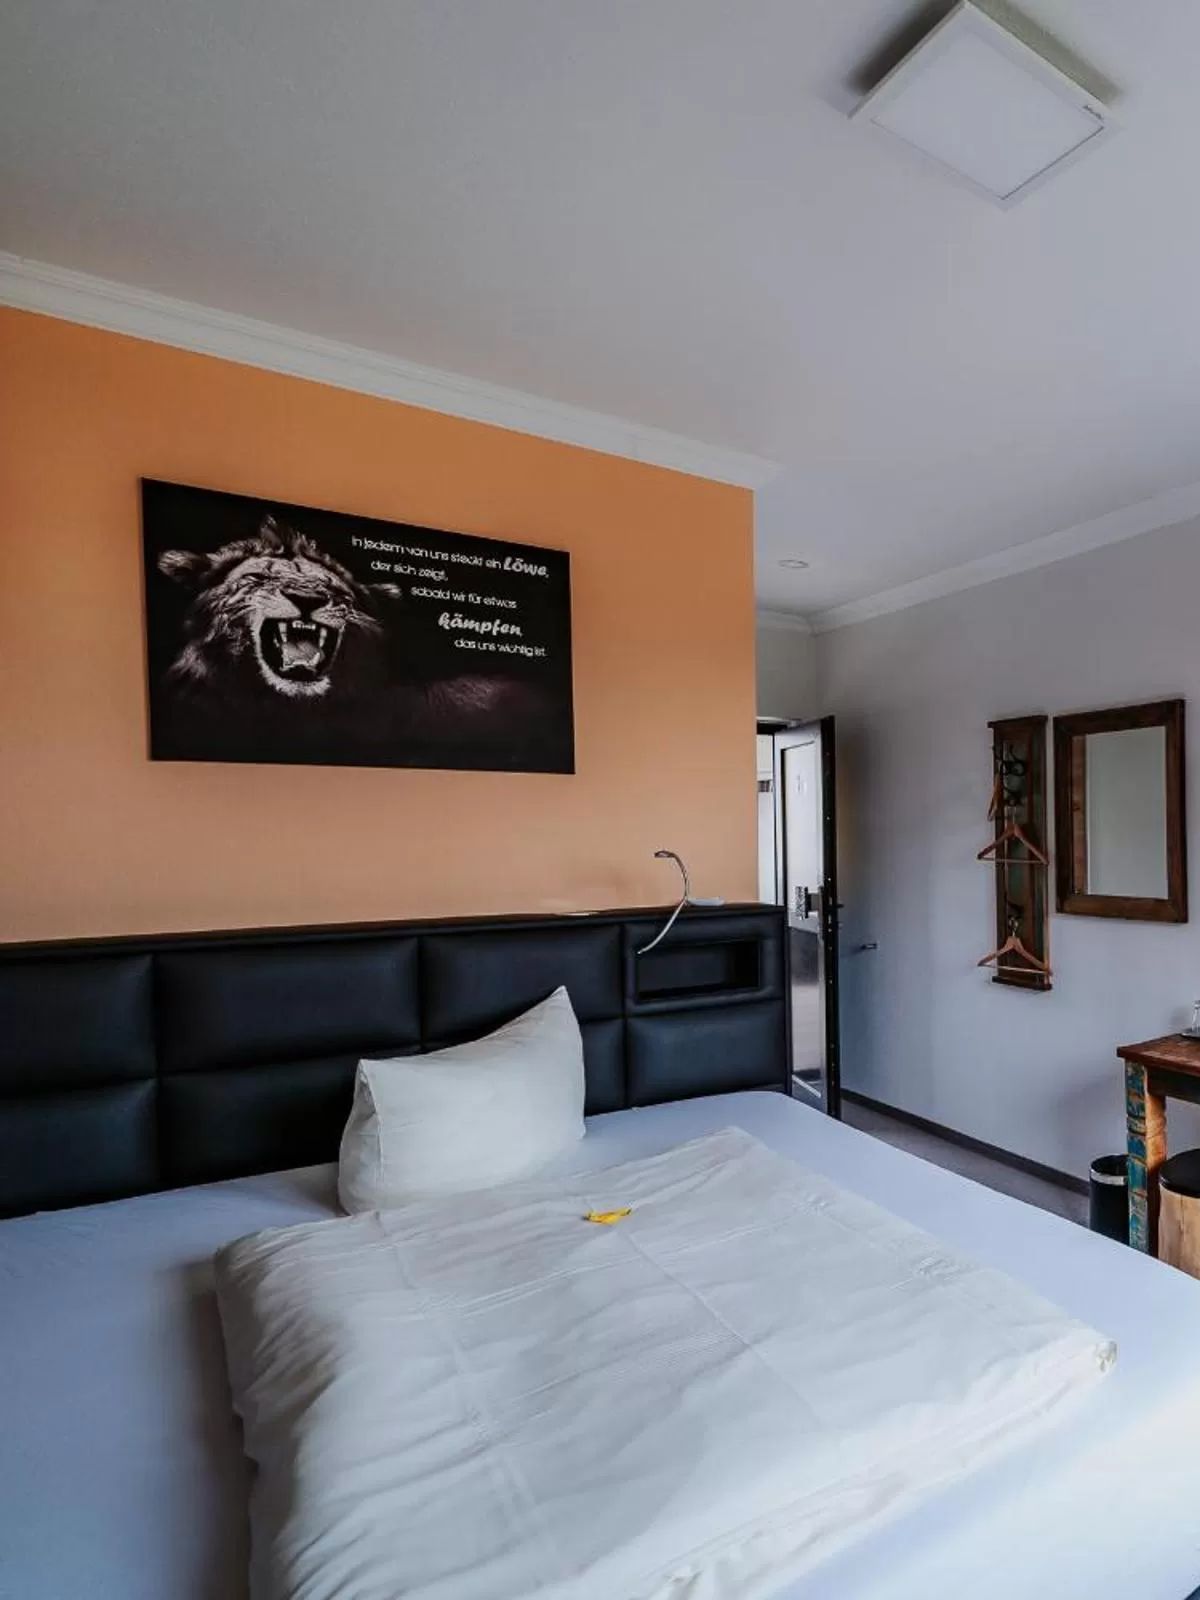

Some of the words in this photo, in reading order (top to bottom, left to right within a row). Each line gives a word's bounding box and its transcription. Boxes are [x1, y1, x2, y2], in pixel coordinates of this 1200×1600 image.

[351, 534, 362, 547] In
[364, 537, 405, 554] jedem
[406, 546, 428, 558] von
[430, 549, 449, 561] uns
[450, 552, 483, 567] steckt
[485, 558, 501, 569] ein
[503, 556, 550, 579] Löwe,
[370, 560, 391, 572] der
[393, 563, 417, 576] sich
[418, 568, 449, 582] zeigt,
[410, 586, 450, 600] sobald
[451, 591, 466, 602] wir
[467, 592, 482, 604] für
[482, 596, 517, 609] etwas
[438, 611, 523, 637] kämpfen,
[454, 638, 476, 649] das
[477, 642, 496, 652] uns
[496, 643, 534, 657] wichtig
